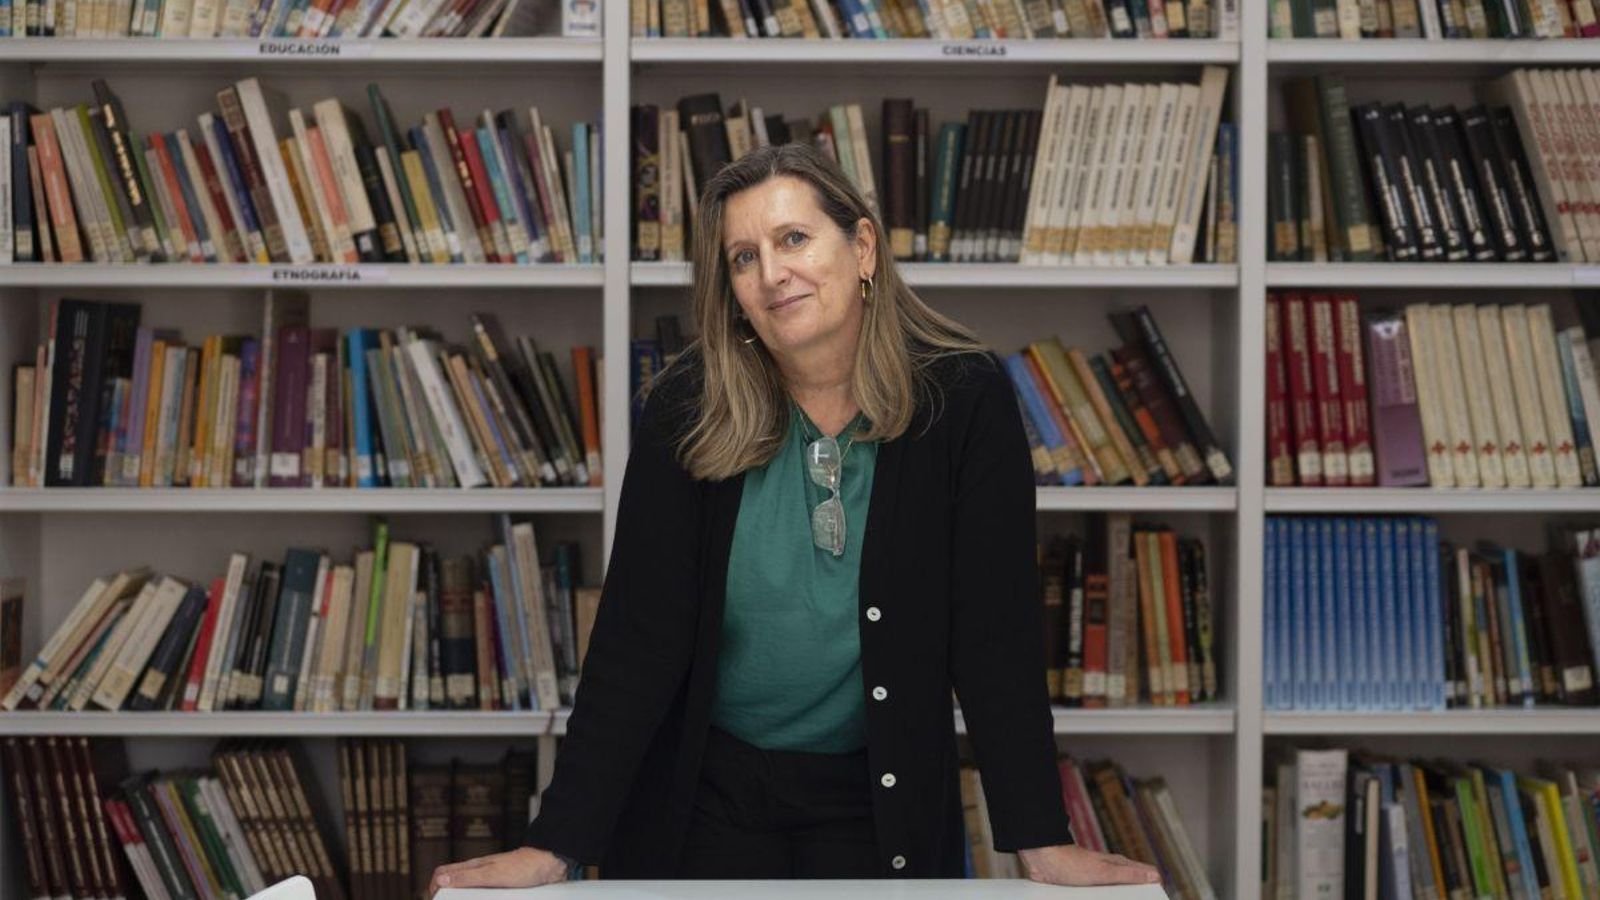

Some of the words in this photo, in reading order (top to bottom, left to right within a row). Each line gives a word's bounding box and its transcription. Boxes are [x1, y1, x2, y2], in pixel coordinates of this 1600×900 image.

[259, 42, 340, 55] EDUCACIÓN
[942, 45, 1006, 56] CIENCIAS
[272, 268, 362, 280] ETNOGRAFÍA
